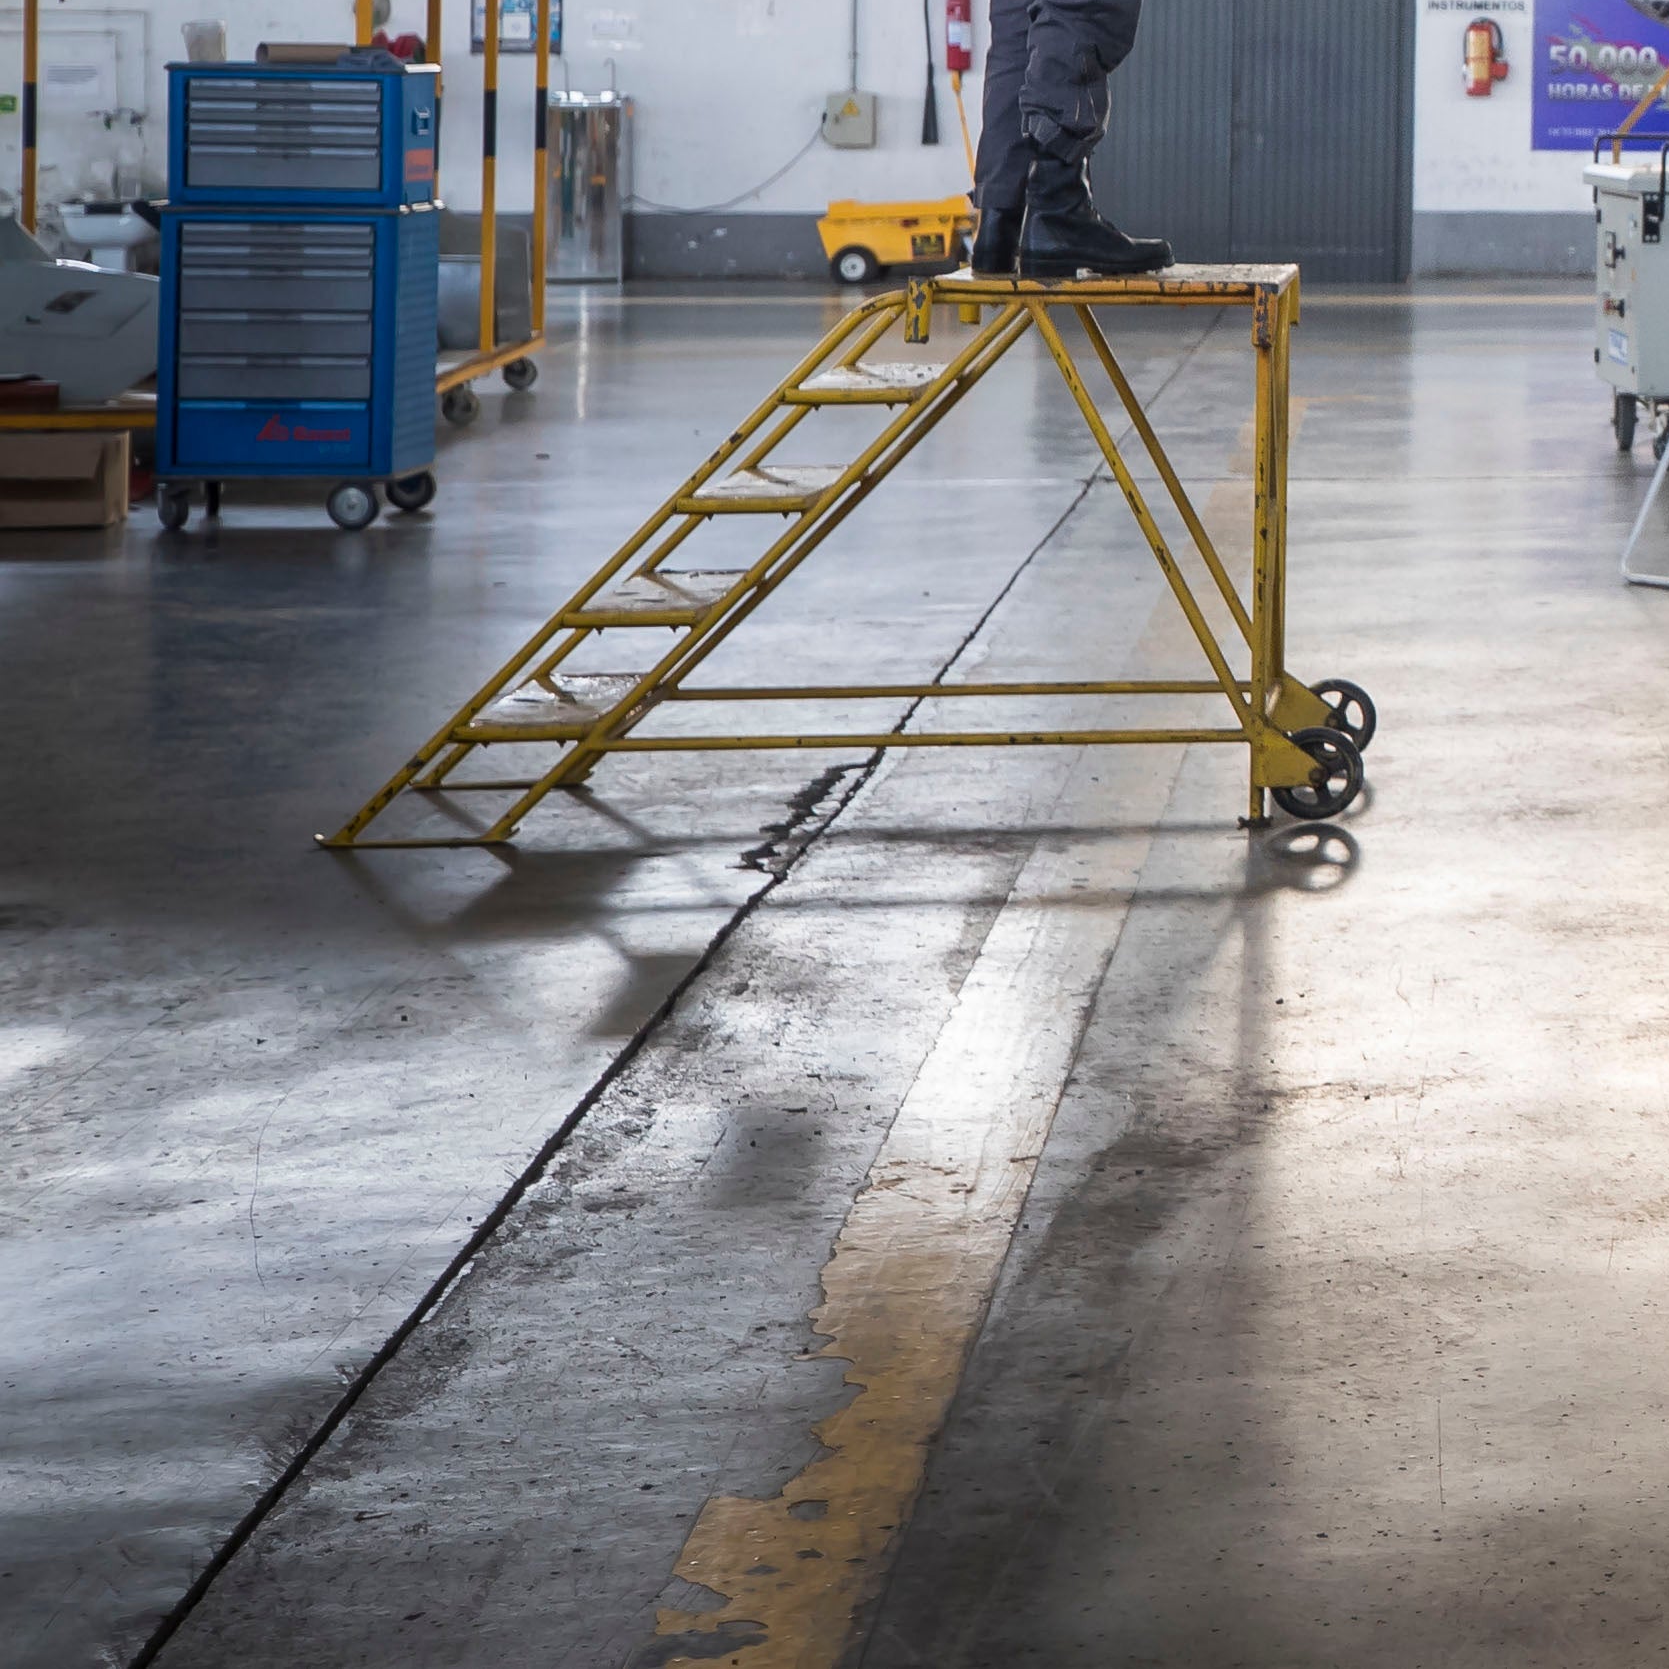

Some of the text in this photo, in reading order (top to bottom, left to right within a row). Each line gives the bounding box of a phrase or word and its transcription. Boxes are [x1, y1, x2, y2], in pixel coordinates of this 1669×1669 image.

[1427, 0, 1526, 12] INSTRUMENTOS
[1548, 83, 1613, 101] HORAS
[1618, 83, 1644, 101] DE
